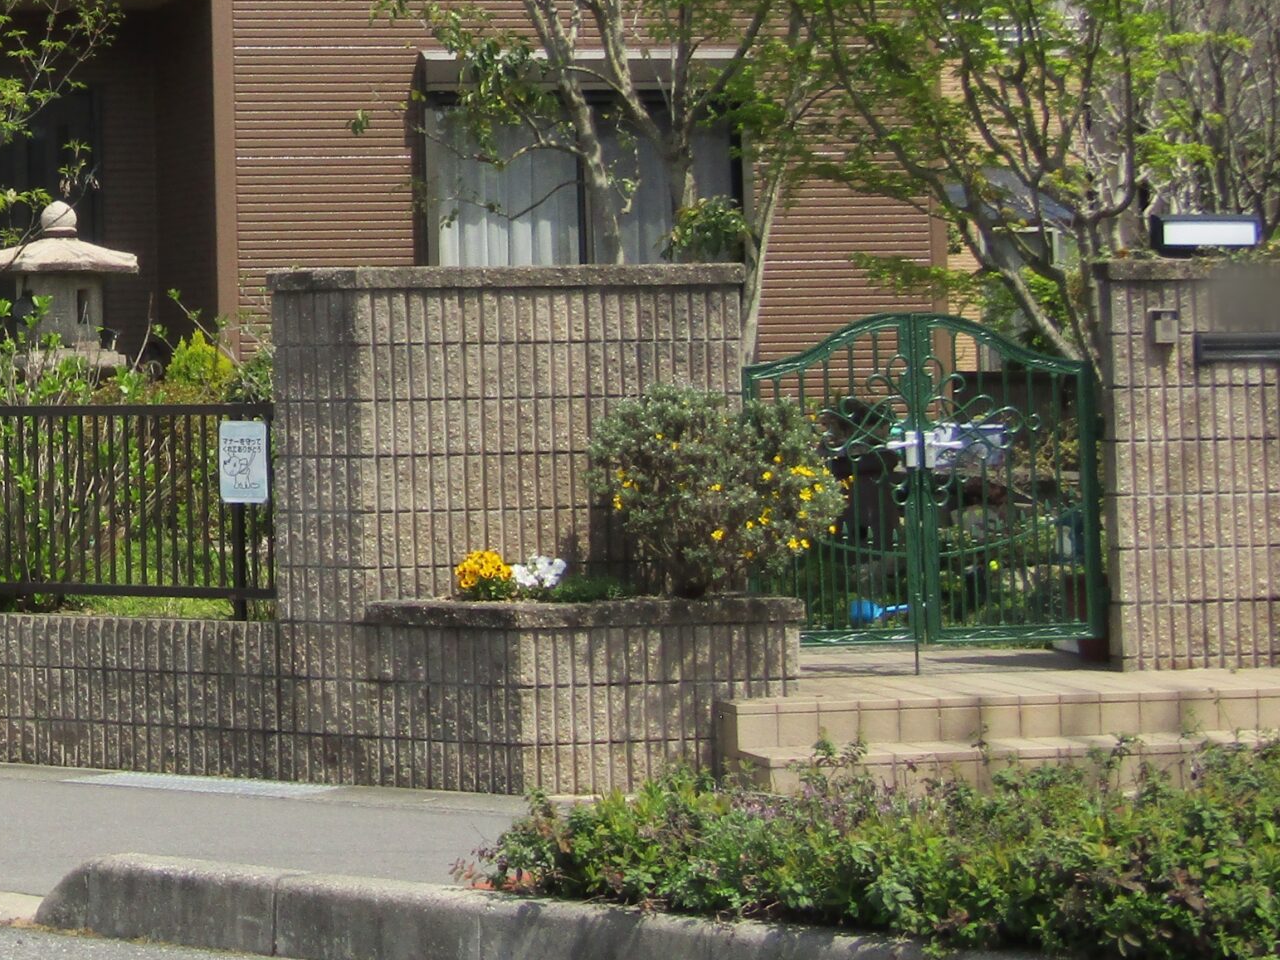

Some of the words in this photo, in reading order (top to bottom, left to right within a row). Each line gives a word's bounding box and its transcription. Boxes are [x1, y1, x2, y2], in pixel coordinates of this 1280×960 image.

[222, 438, 262, 446] マナーを守って
